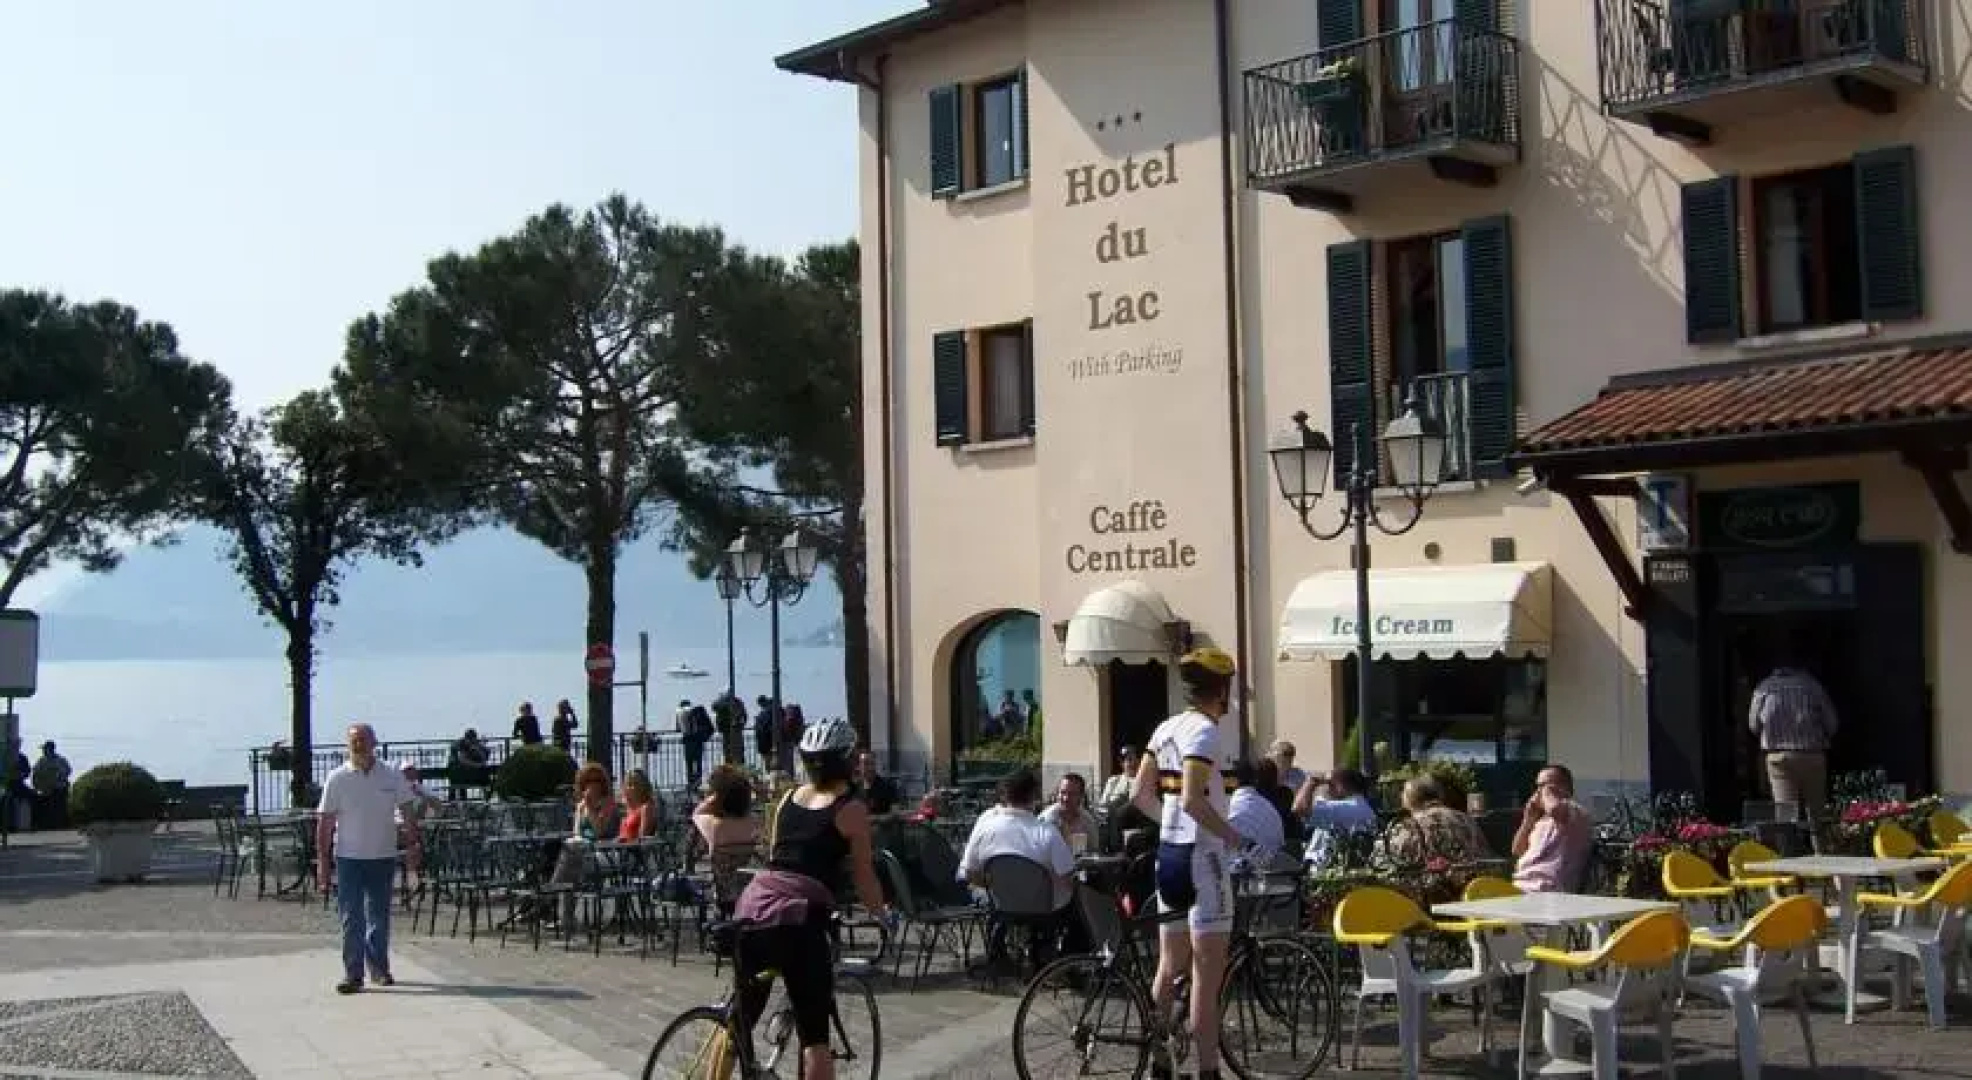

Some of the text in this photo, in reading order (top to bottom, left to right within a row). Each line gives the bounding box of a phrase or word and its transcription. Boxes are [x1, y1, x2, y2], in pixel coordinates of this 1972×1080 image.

[1064, 142, 1179, 207] Hotel
[1095, 221, 1149, 264] du
[1086, 289, 1161, 331] Lac
[1068, 345, 1183, 381] With Parking
[1089, 500, 1167, 533] Caffè
[1067, 539, 1196, 573] Centrale
[1375, 614, 1454, 635] Cream
